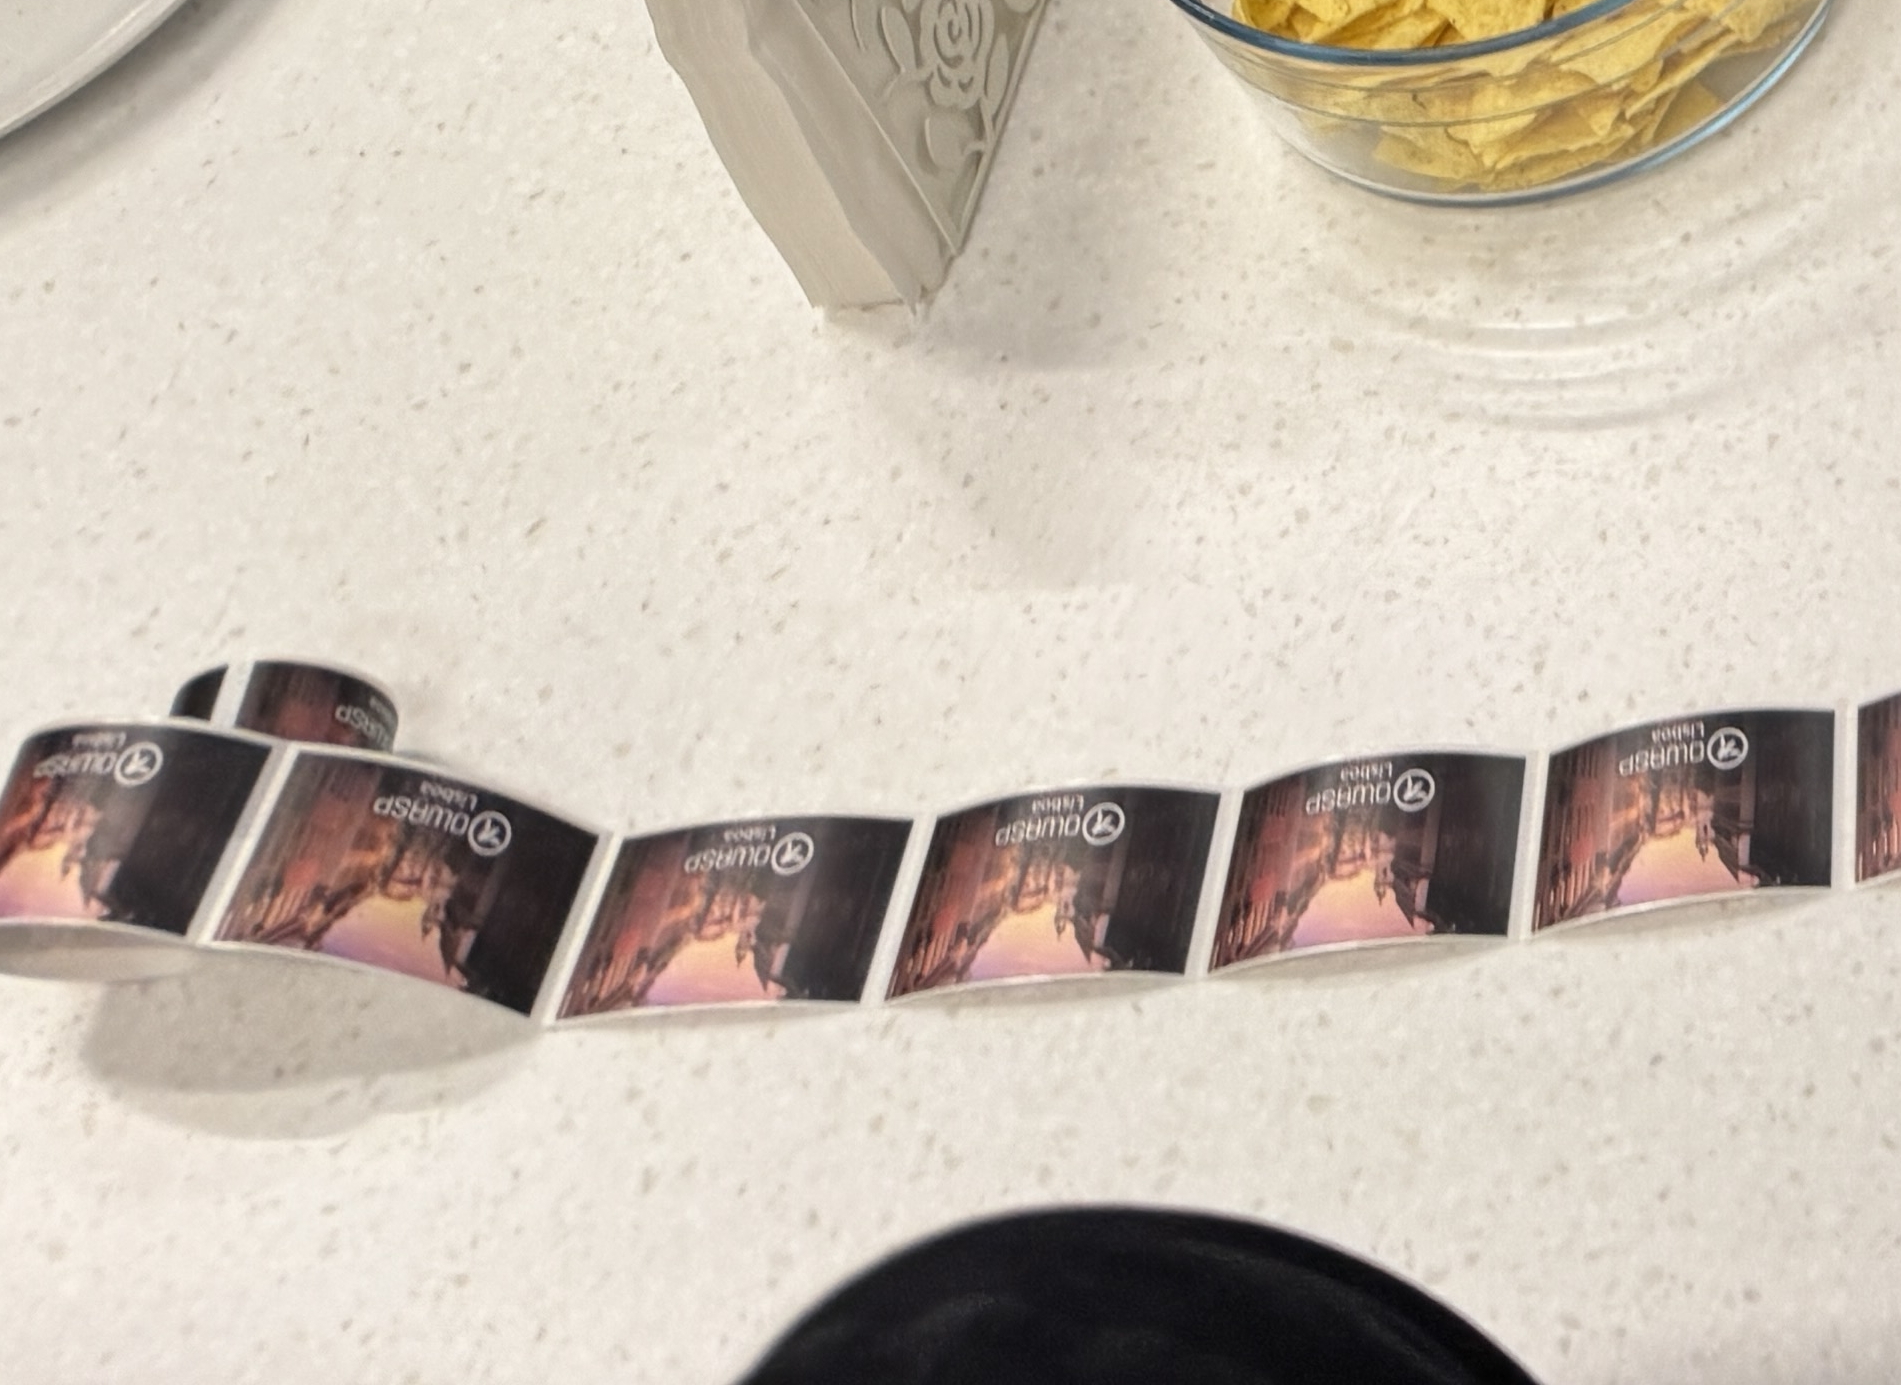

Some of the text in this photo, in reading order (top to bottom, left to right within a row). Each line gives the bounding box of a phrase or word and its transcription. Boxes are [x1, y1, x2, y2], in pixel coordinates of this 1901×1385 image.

[1618, 739, 1705, 777] OWASP
[1305, 780, 1391, 815] OWASP
[373, 795, 470, 836] OWASP
[995, 814, 1080, 847] OWASP
[684, 843, 771, 874] OWASP
